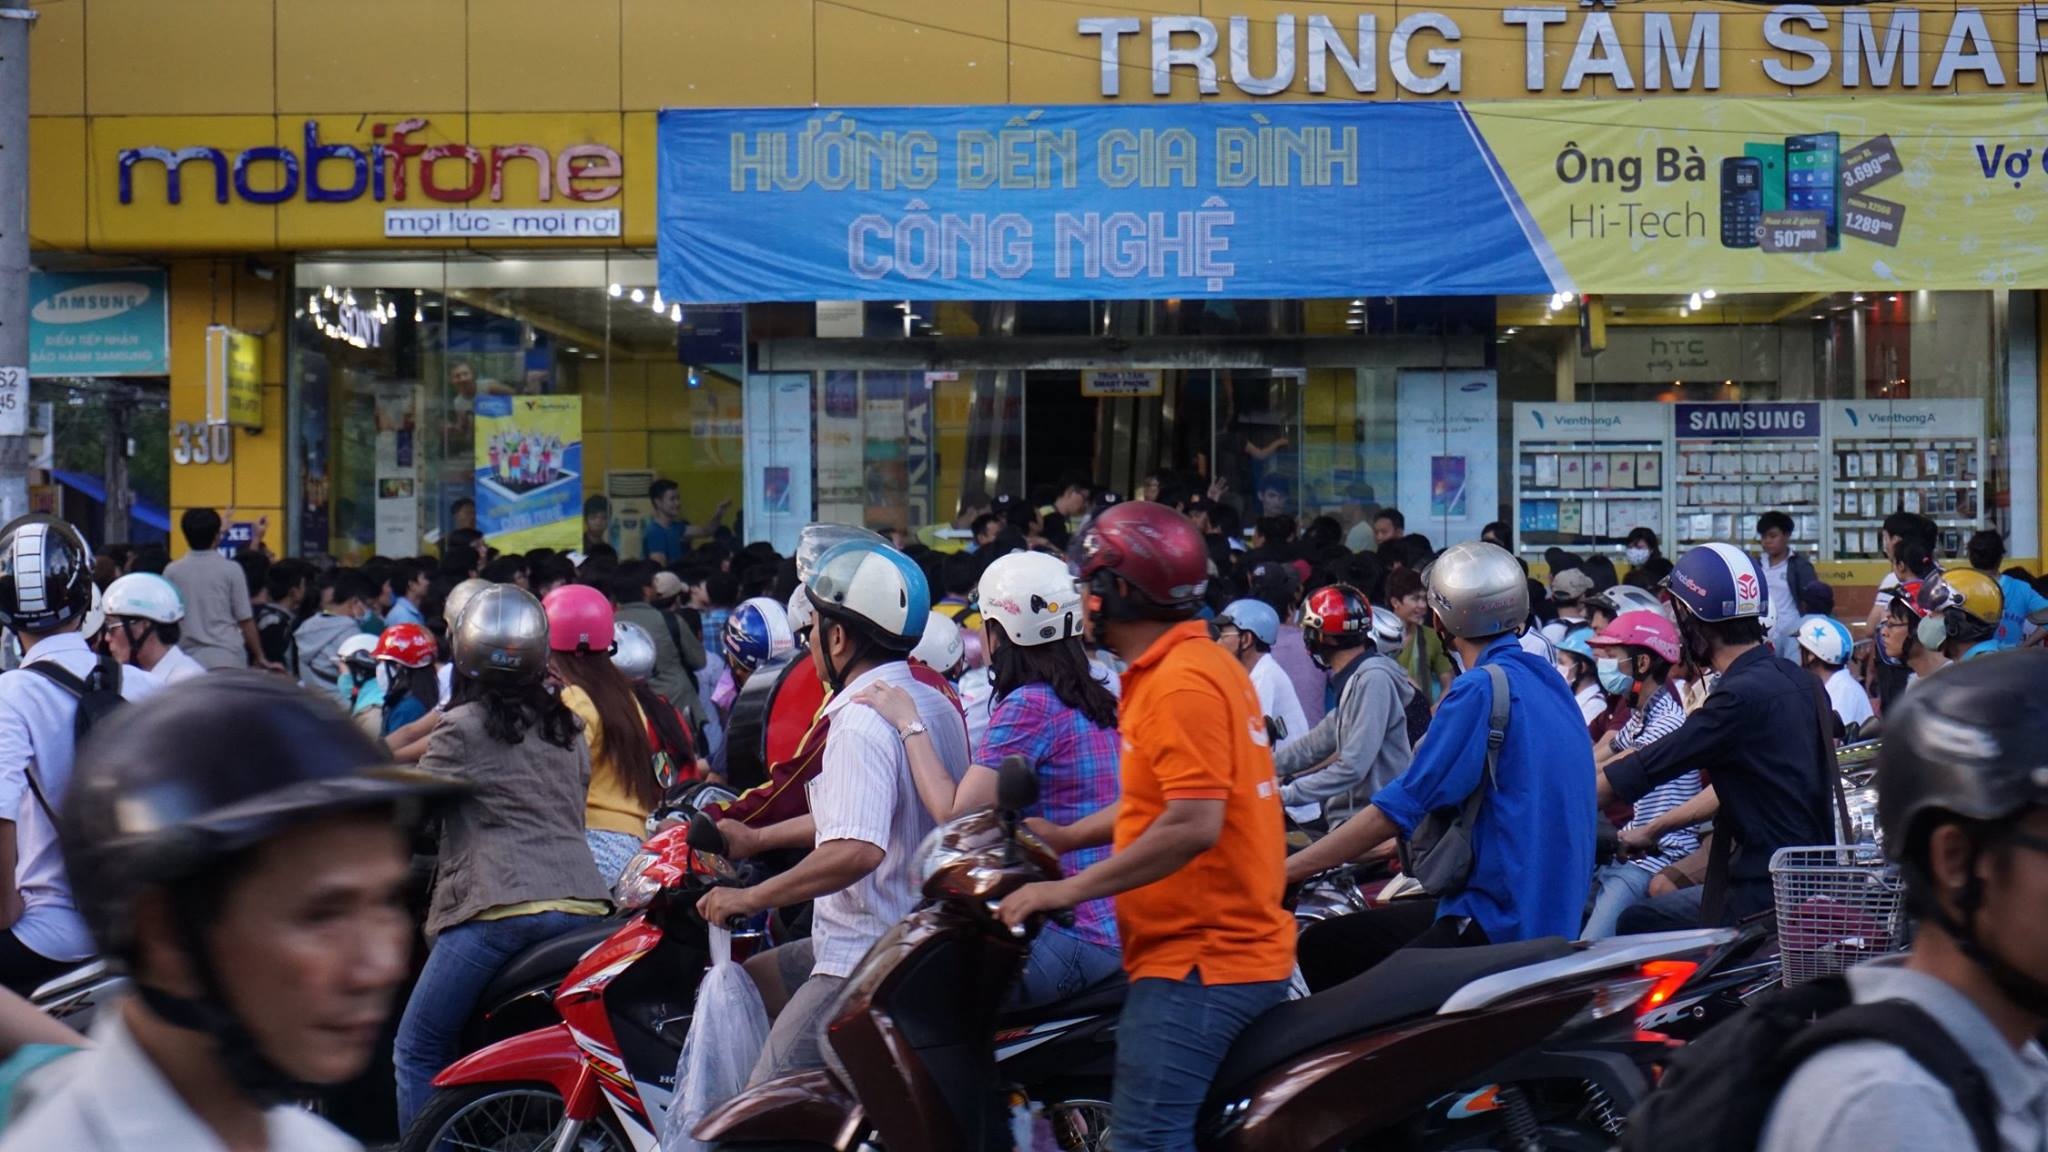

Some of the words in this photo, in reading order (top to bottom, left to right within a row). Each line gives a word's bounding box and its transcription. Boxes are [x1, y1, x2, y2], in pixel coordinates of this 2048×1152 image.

[1078, 13, 1462, 96] TRUNG
[118, 118, 623, 205] mobifone
[730, 111, 938, 192] HƯỚNG
[957, 110, 1077, 190] ĐẾN
[1098, 128, 1197, 189] GIA
[1216, 112, 1358, 187] ĐÌNH
[1556, 141, 1643, 193] Ông
[1656, 146, 1706, 183] Bà
[1976, 144, 2033, 190] Vợ
[388, 212, 441, 234] mọi
[450, 212, 491, 232] lúc
[513, 212, 565, 234] mọi
[1570, 201, 1706, 239] Hi-Tech
[849, 199, 1033, 280] CÔNG
[1055, 196, 1235, 292] NGHỆ
[46, 294, 138, 311] SAMSUNG
[338, 303, 382, 348] SONY
[1689, 410, 1806, 431] SAMSUNG
[1868, 413, 1936, 425] VienthongA
[173, 420, 230, 465] 330
